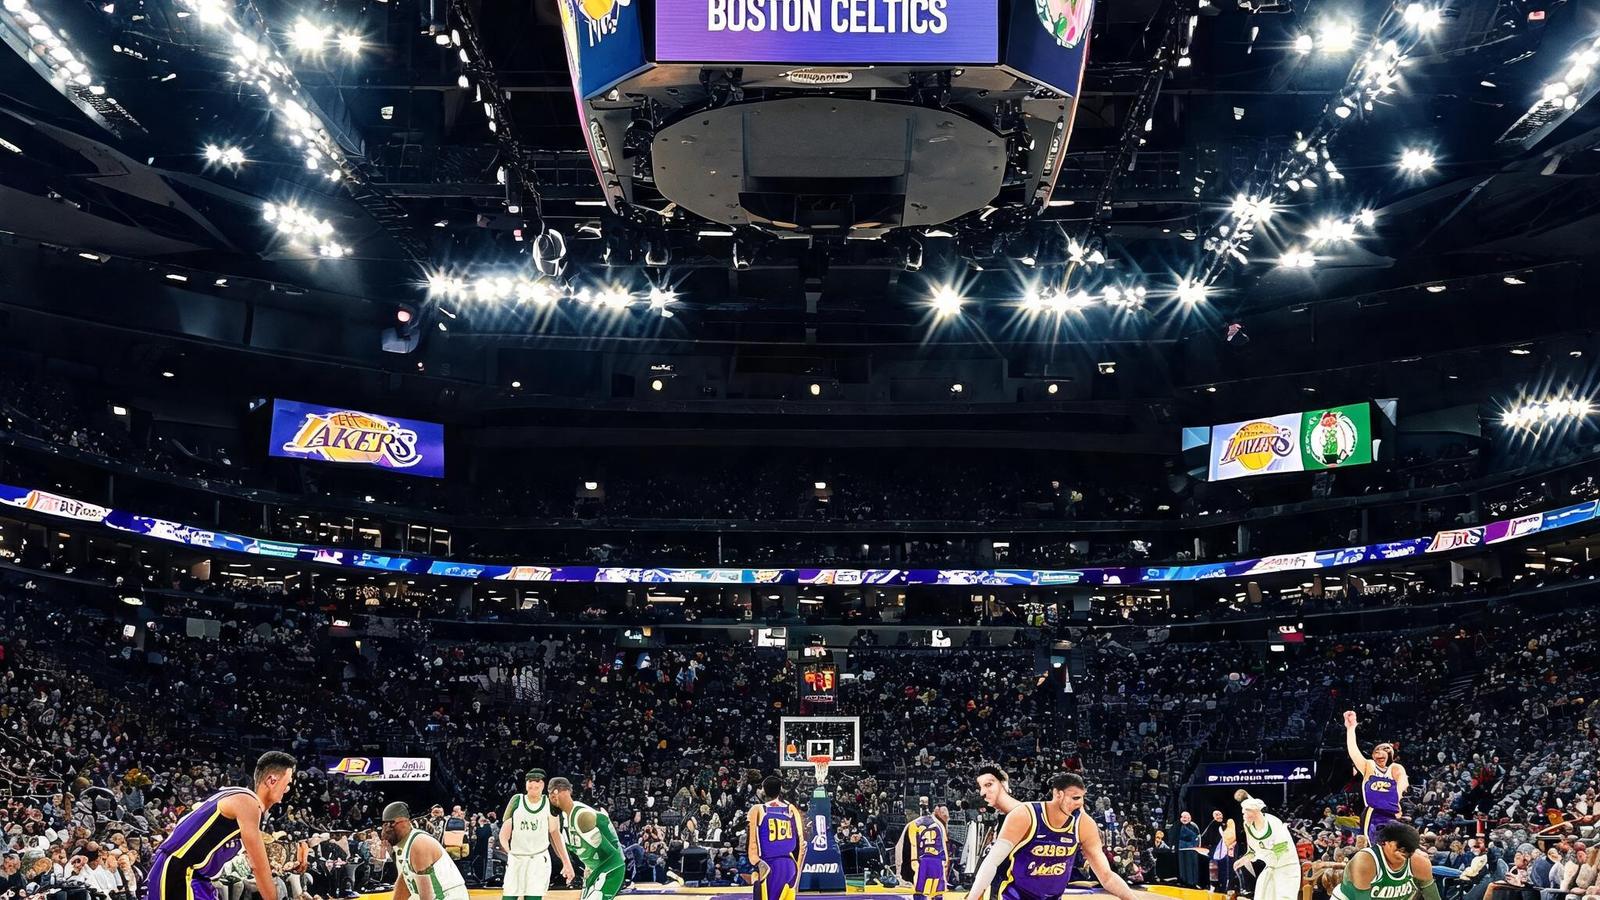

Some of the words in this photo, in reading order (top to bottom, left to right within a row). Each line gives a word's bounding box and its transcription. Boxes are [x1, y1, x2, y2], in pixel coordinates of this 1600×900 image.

[708, 0, 821, 32] BOSTON
[831, 0, 948, 34] CELTICS
[283, 413, 423, 467] LAKERS
